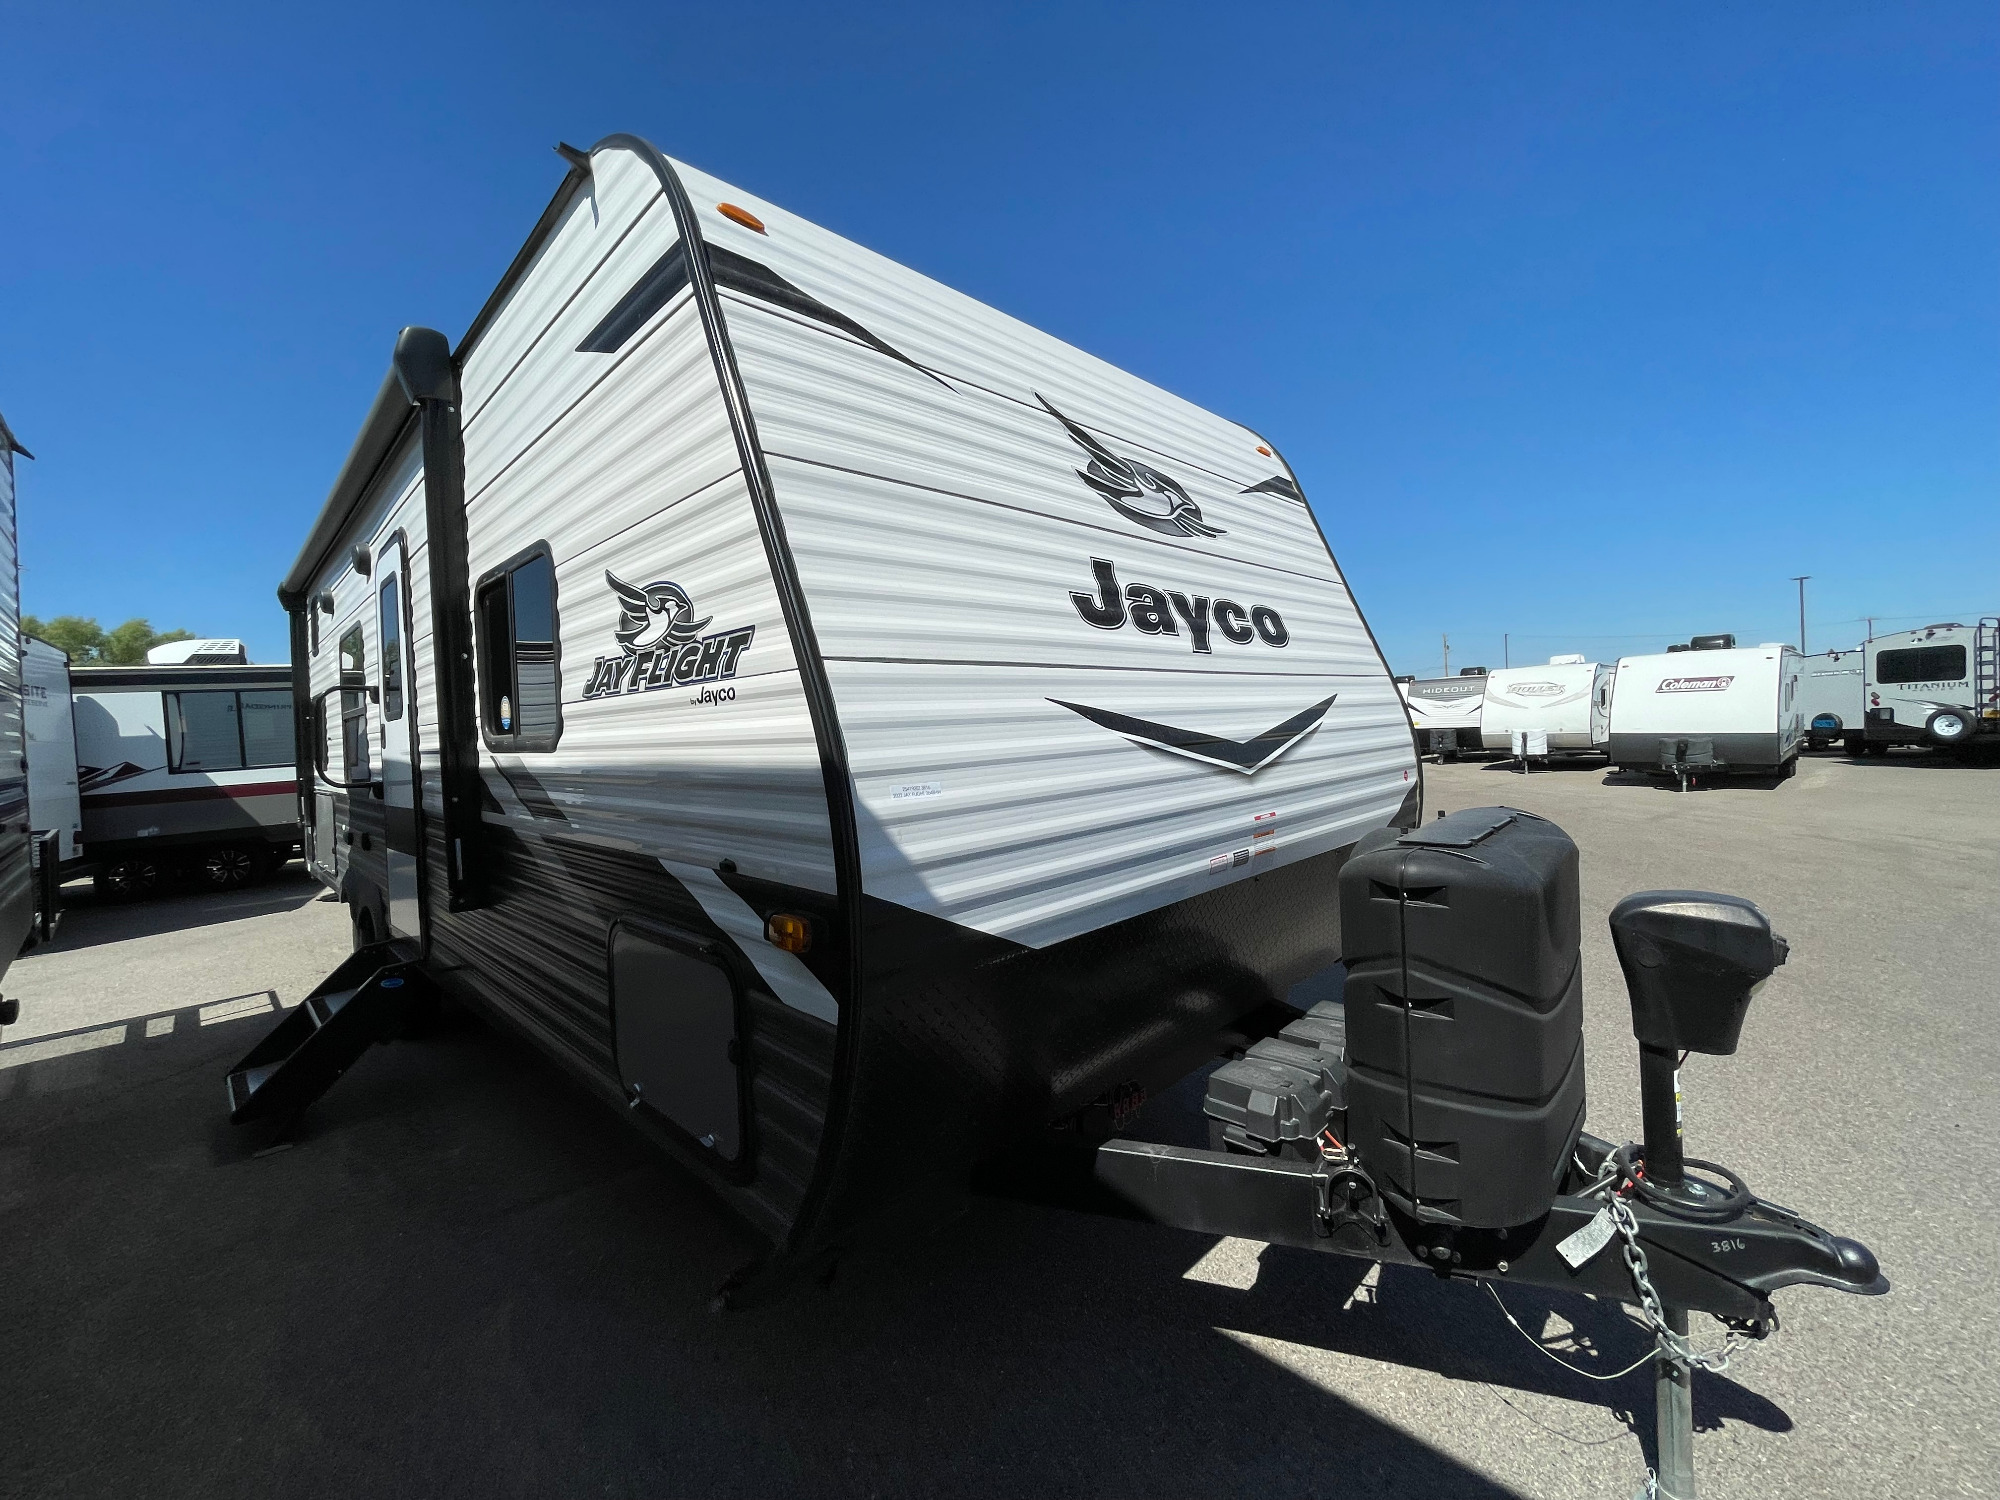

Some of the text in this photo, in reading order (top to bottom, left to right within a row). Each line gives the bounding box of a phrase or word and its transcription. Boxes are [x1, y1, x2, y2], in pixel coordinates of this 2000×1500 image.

[1068, 556, 1290, 654] Jayco
[582, 625, 756, 699] JAY FLIGHT
[1422, 685, 1475, 695] HIDEOUT
[1661, 678, 1717, 690] Coleman
[1896, 681, 1970, 690] TITANIUM
[689, 686, 736, 706] by Jayco
[1711, 1237, 1746, 1253] 3816
